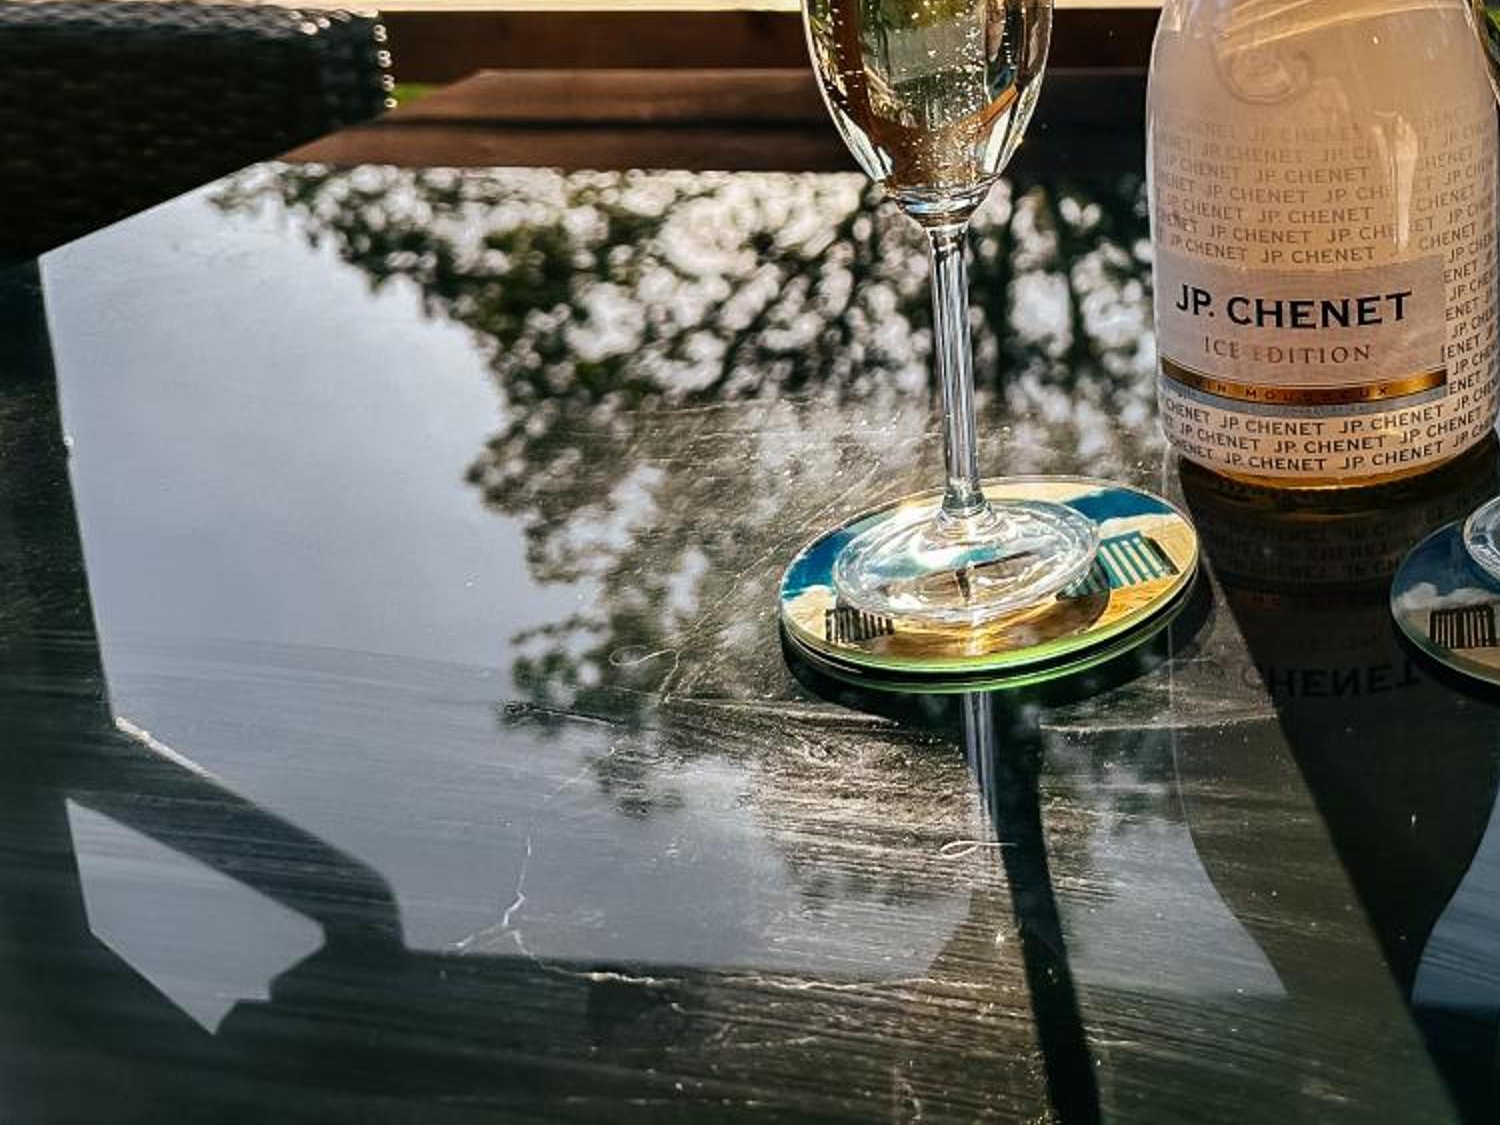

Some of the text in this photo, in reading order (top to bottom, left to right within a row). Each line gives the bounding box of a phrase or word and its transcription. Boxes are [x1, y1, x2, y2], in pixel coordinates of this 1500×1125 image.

[1284, 166, 1370, 185] CHENET
[1229, 186, 1312, 205] CHENET
[1181, 197, 1244, 221] CHENET
[1286, 205, 1376, 225] CHENET
[1185, 237, 1248, 263] CHENET
[1291, 245, 1376, 265] CHENET
[1418, 221, 1477, 252] CHENET
[1232, 226, 1313, 245] CHENET
[1176, 283, 1413, 330] JP. CHENET
[1204, 336, 1372, 364] ICE EDITION
[1197, 428, 1261, 452] CHENET
[1303, 435, 1387, 455] CHENET
[1426, 405, 1482, 439] CHENET
[1245, 419, 1326, 437] CHENET
[1370, 403, 1444, 431] CHENET
[1248, 456, 1328, 473] CHENET
[1371, 441, 1443, 467] CHENET
